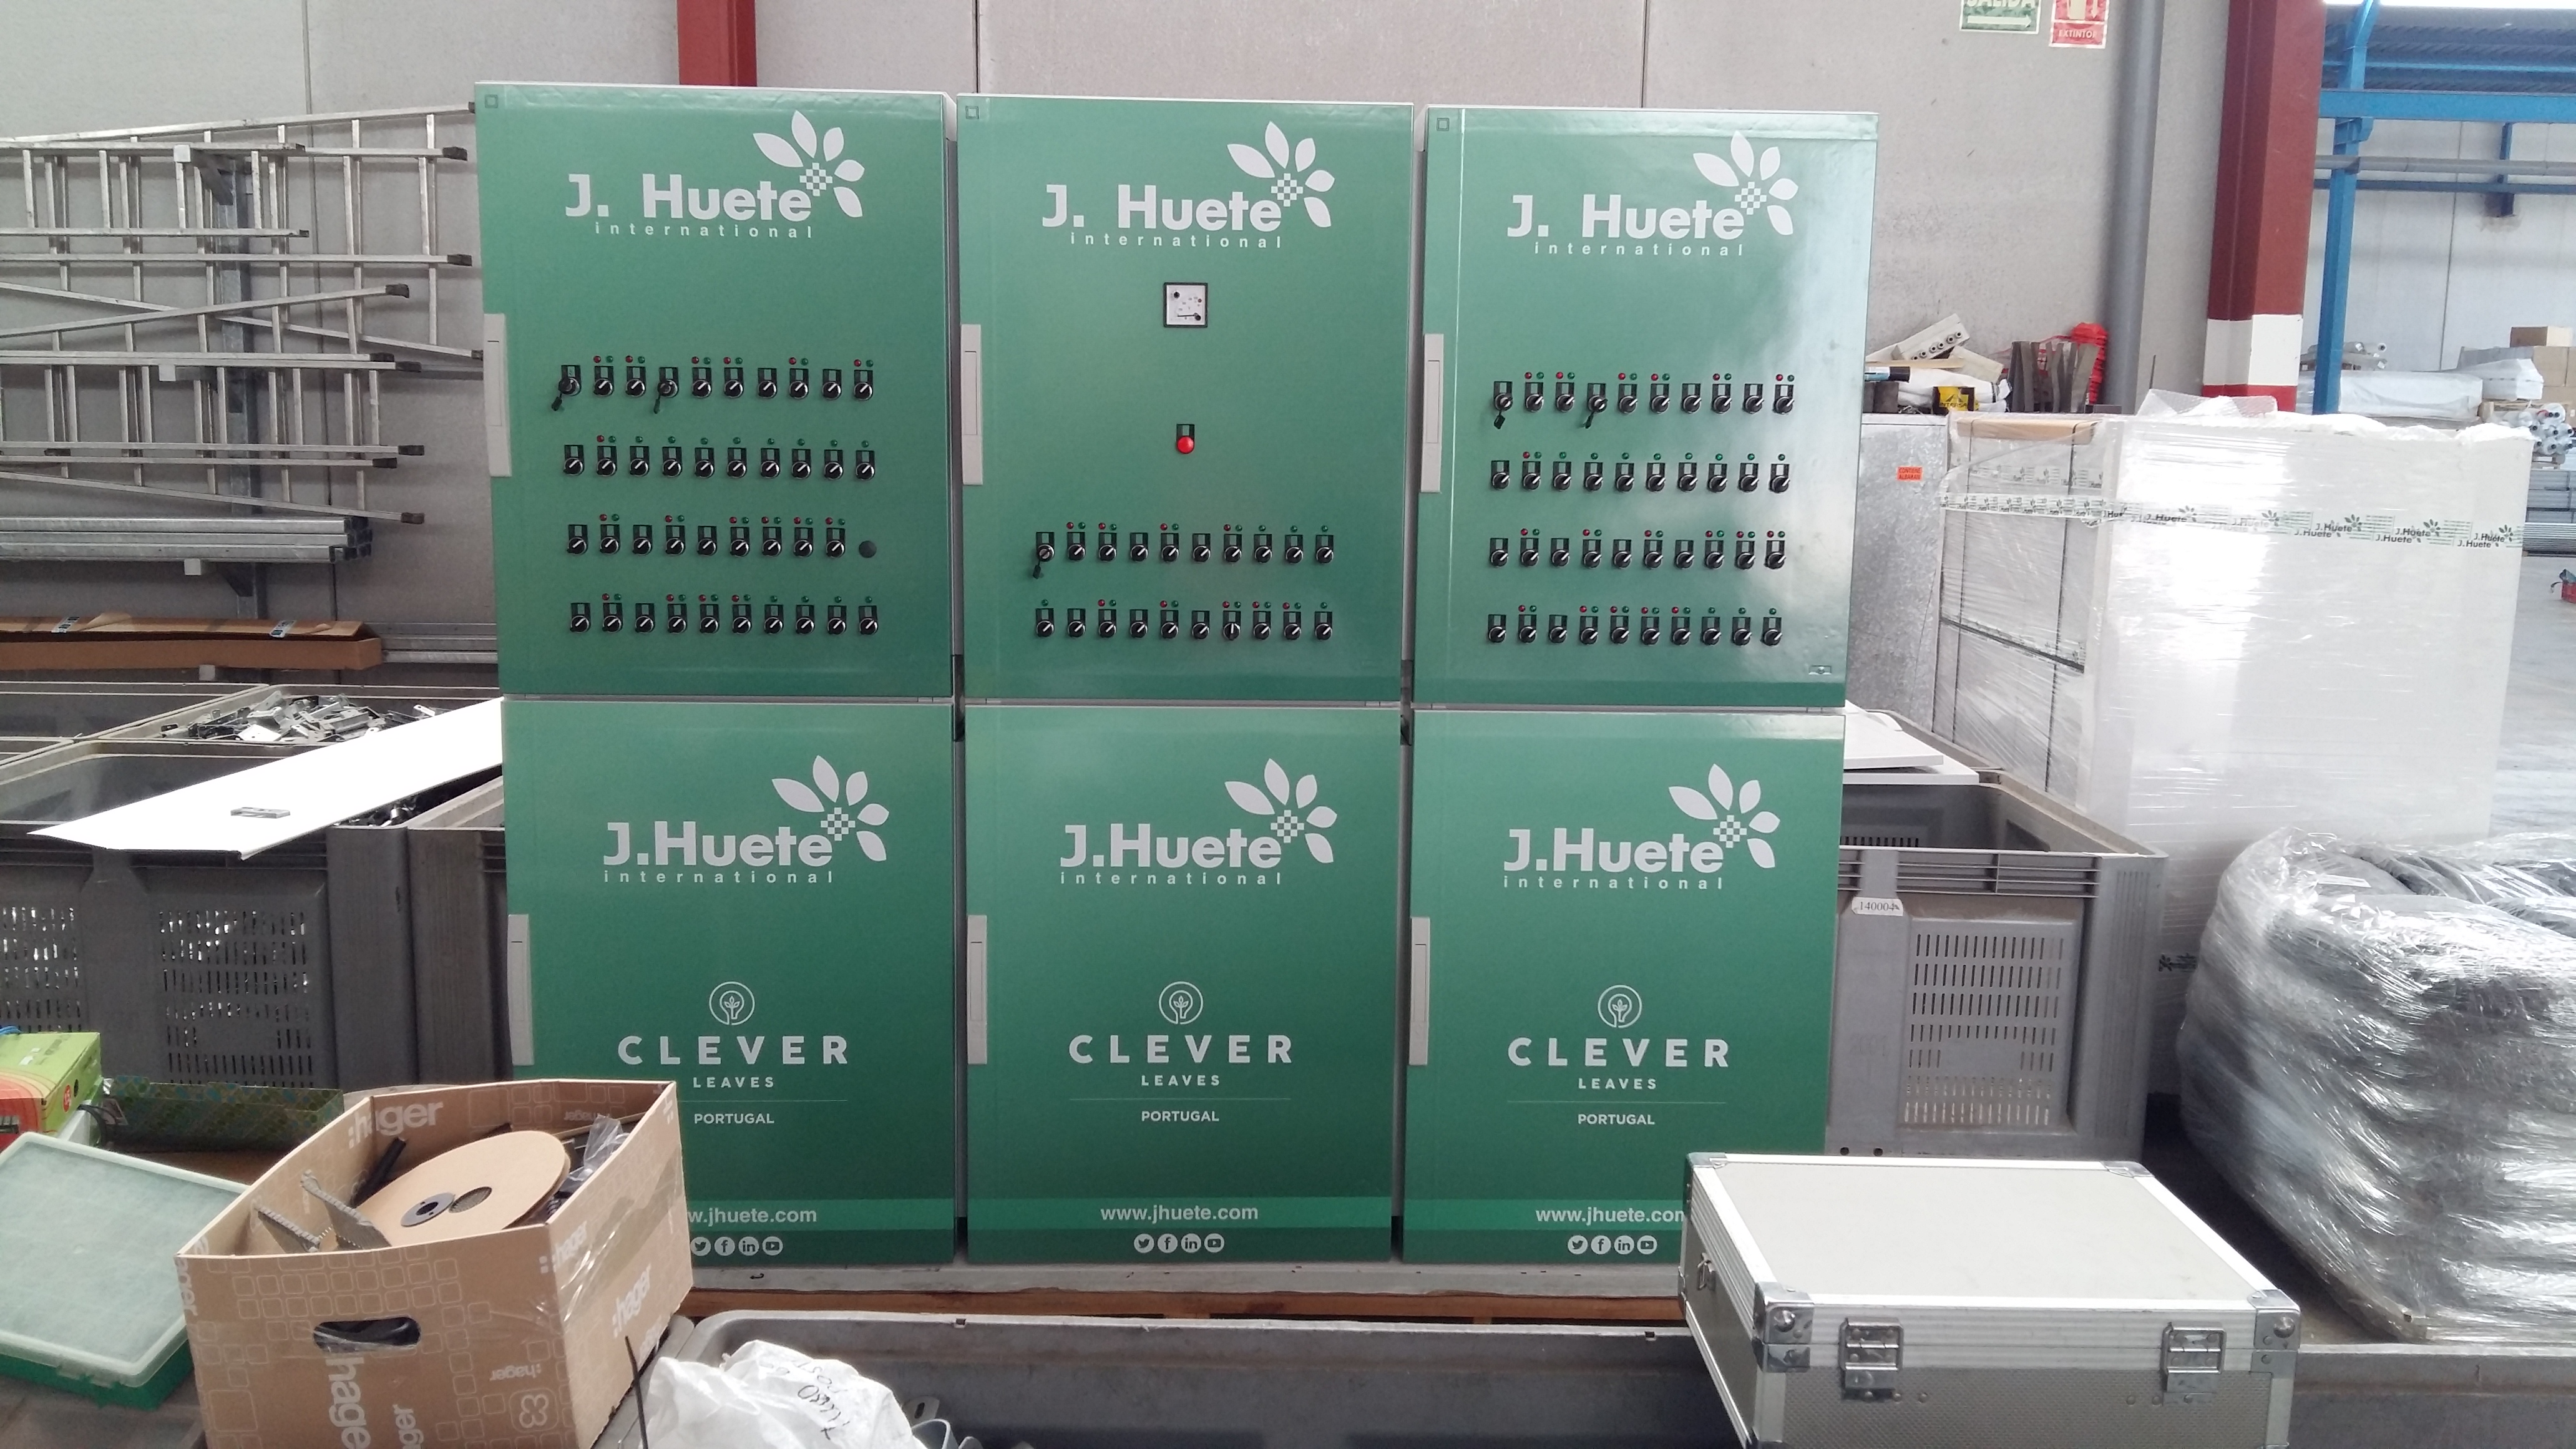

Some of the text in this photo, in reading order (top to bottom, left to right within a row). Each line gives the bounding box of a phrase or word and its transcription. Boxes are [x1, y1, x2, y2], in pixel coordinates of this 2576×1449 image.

[565, 174, 811, 221] J. Huete
[1042, 185, 1281, 232] J. Huete
[1507, 194, 1744, 240] J. Huete
[595, 222, 811, 238] international
[1071, 232, 1281, 248] international
[1535, 242, 1742, 256] international
[2375, 534, 2413, 544] J.Huete
[2457, 540, 2492, 549] J.Huete
[603, 821, 833, 867] J.Huete
[1060, 823, 1282, 869] J.Huete
[1504, 827, 1724, 873] J.Huete
[604, 871, 832, 884] international
[1061, 872, 1281, 885] international
[1504, 876, 1722, 889] international
[618, 1036, 848, 1065] CLEVER
[1069, 1035, 1292, 1063] CLEVER
[1508, 1037, 1729, 1067] CLEVER
[693, 1077, 774, 1088] LEAVES
[1141, 1075, 1220, 1086] LEAVES
[1578, 1078, 1656, 1089] LEAVES
[694, 1114, 774, 1124] PORTUGAL
[1141, 1111, 1219, 1121] PORTUGAL
[1578, 1114, 1655, 1125] PORTUGAL
[688, 1208, 817, 1227] w.jhuete.com
[1100, 1205, 1259, 1224] www.jhuete.com
[325, 1357, 371, 1449] hage
